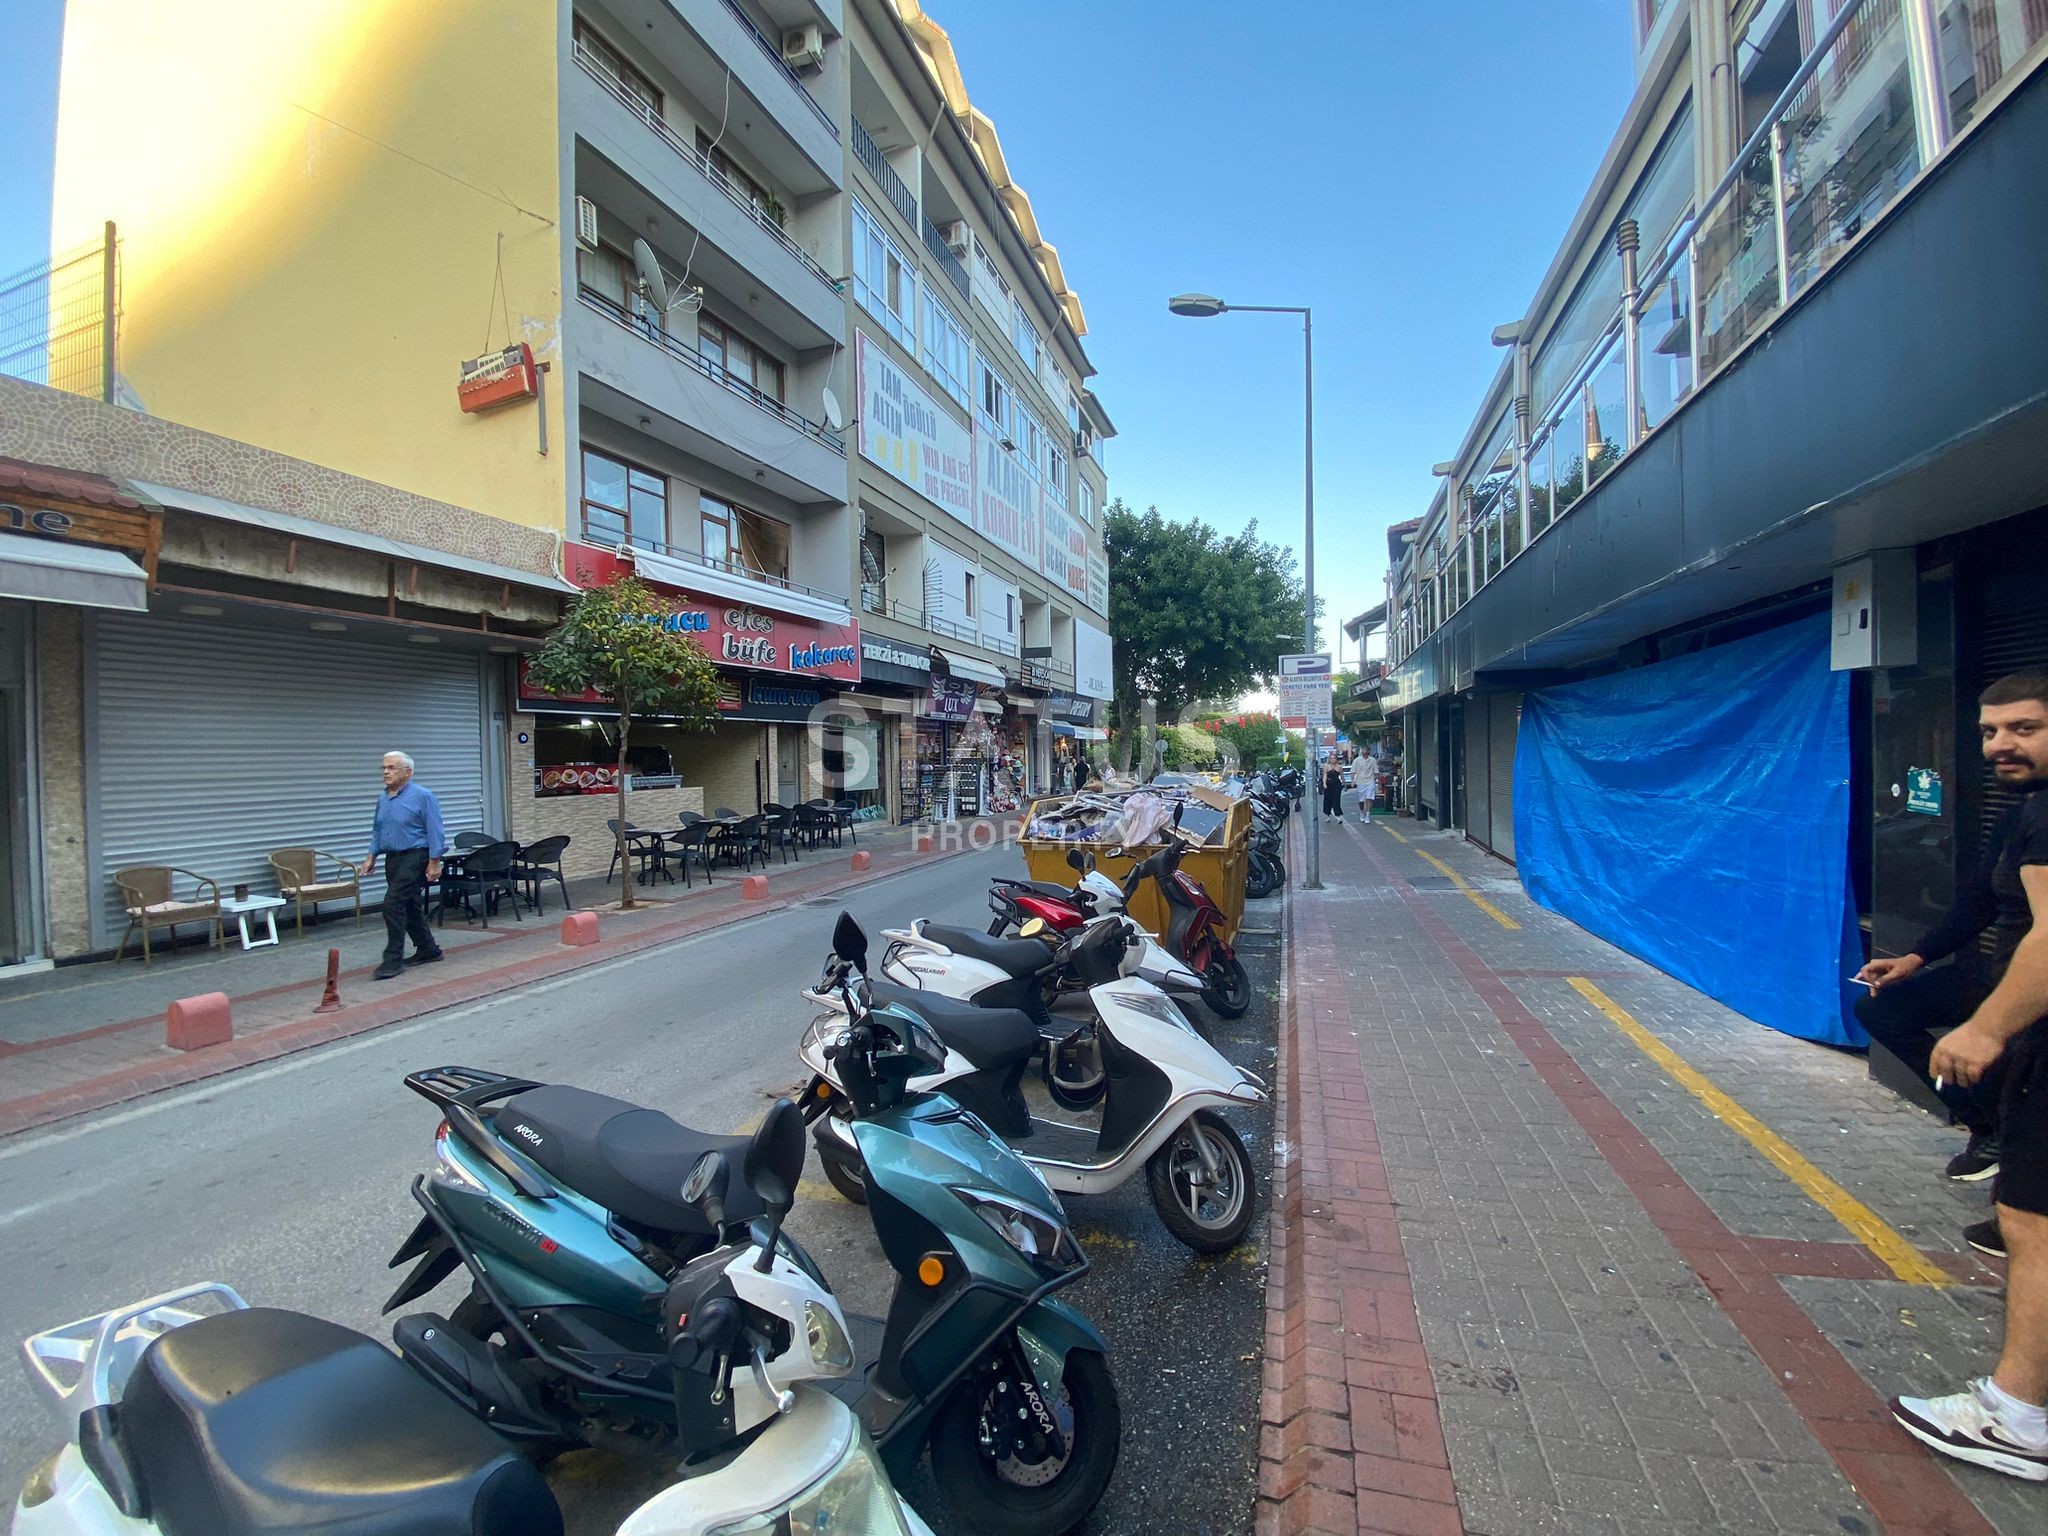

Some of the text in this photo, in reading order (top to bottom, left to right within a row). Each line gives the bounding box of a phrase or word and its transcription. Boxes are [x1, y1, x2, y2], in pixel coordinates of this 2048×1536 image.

[879, 360, 902, 406] TAM
[872, 390, 903, 440] ALTIN
[924, 471, 939, 499] BIG
[724, 604, 775, 633] efes
[722, 632, 778, 665] büfe
[862, 643, 892, 664] TERZİ
[1283, 657, 1329, 674] P
[944, 697, 960, 713] LUX
[513, 1123, 544, 1147] ARORA
[1020, 1381, 1055, 1434] ARORA
